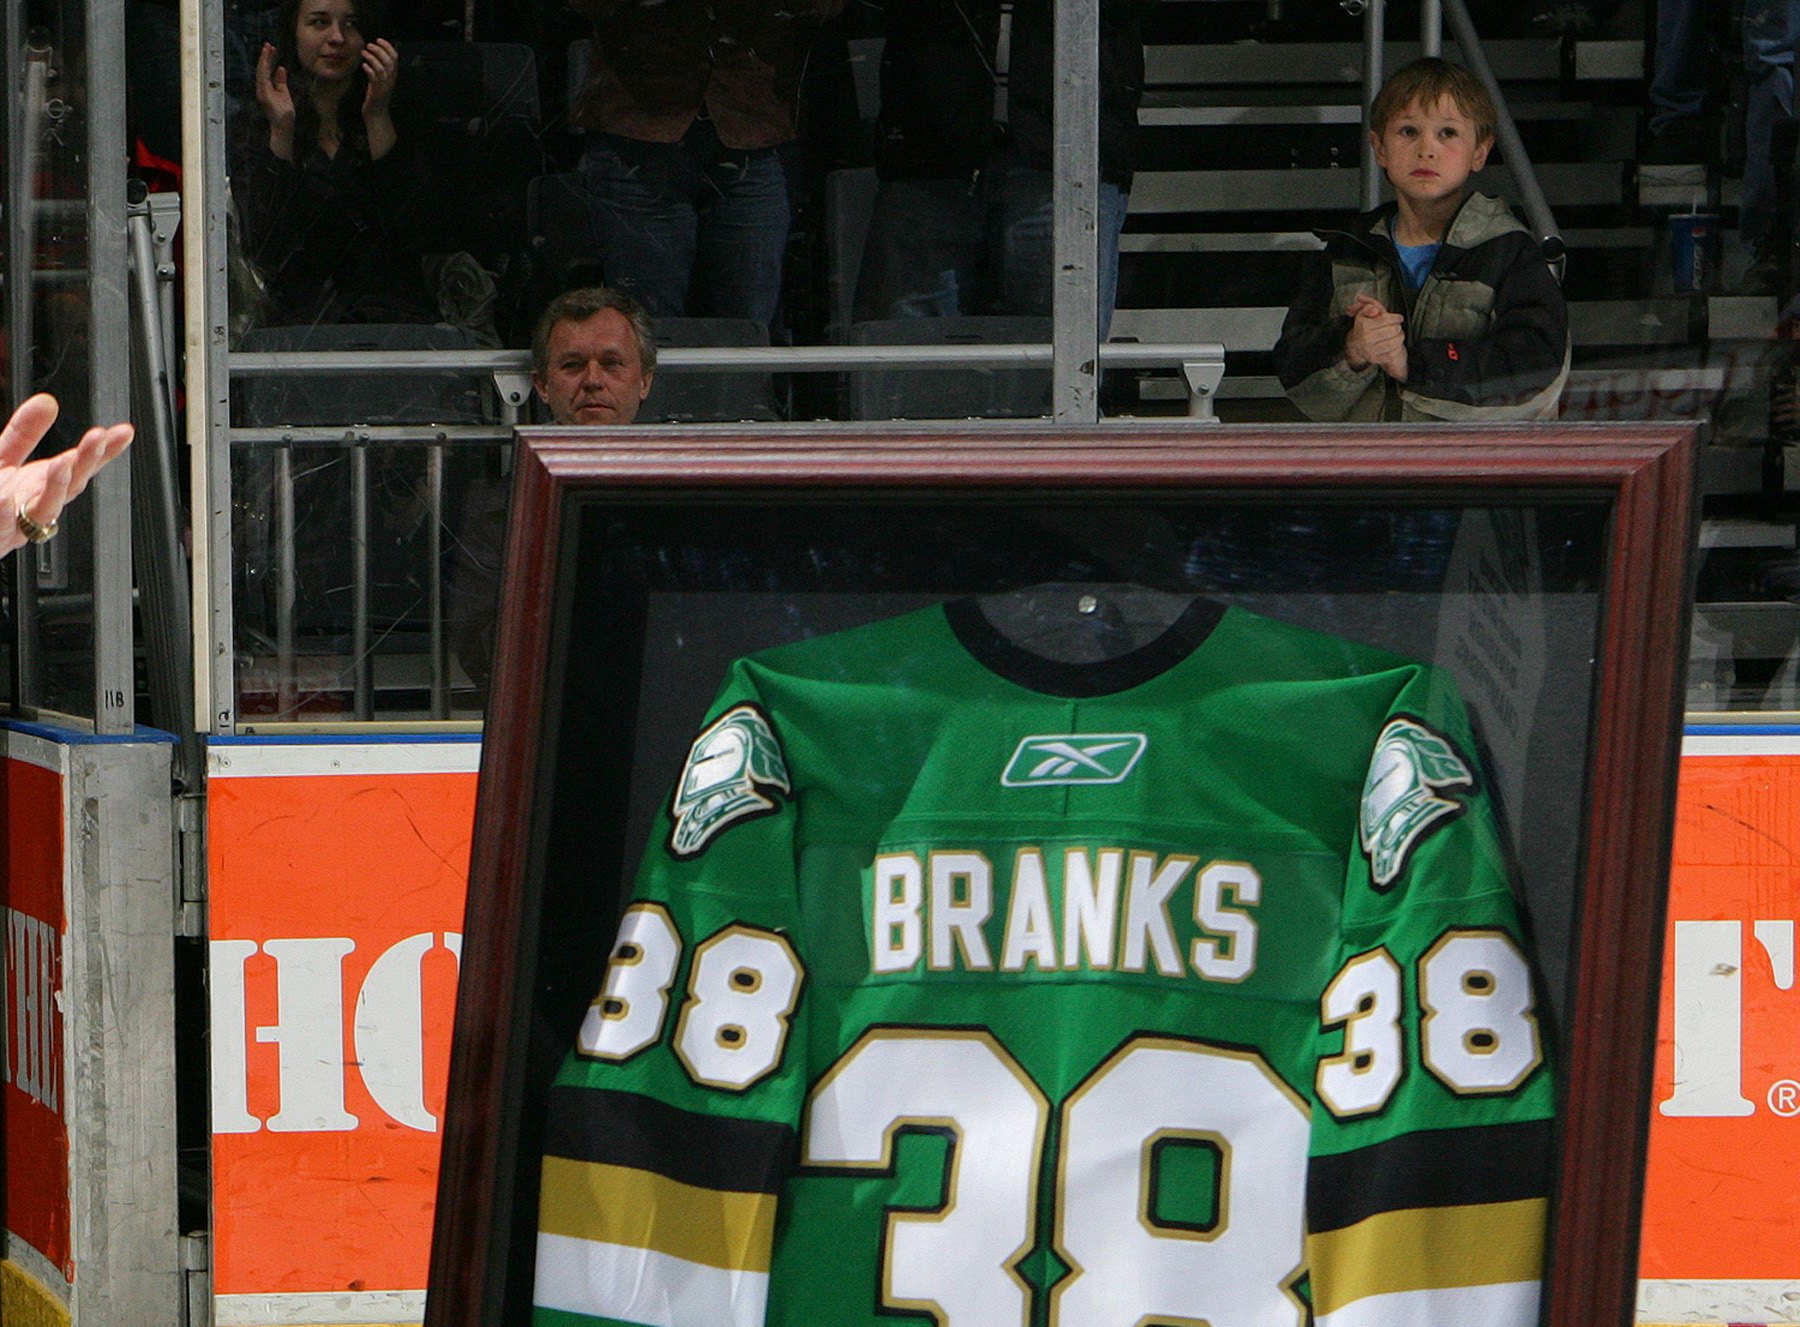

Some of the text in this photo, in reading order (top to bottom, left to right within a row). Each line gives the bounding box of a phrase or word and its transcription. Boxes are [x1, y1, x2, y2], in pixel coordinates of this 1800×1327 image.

[576, 900, 805, 1094] 38
[871, 846, 1262, 983] BRANKS
[1315, 925, 1545, 1123] 38
